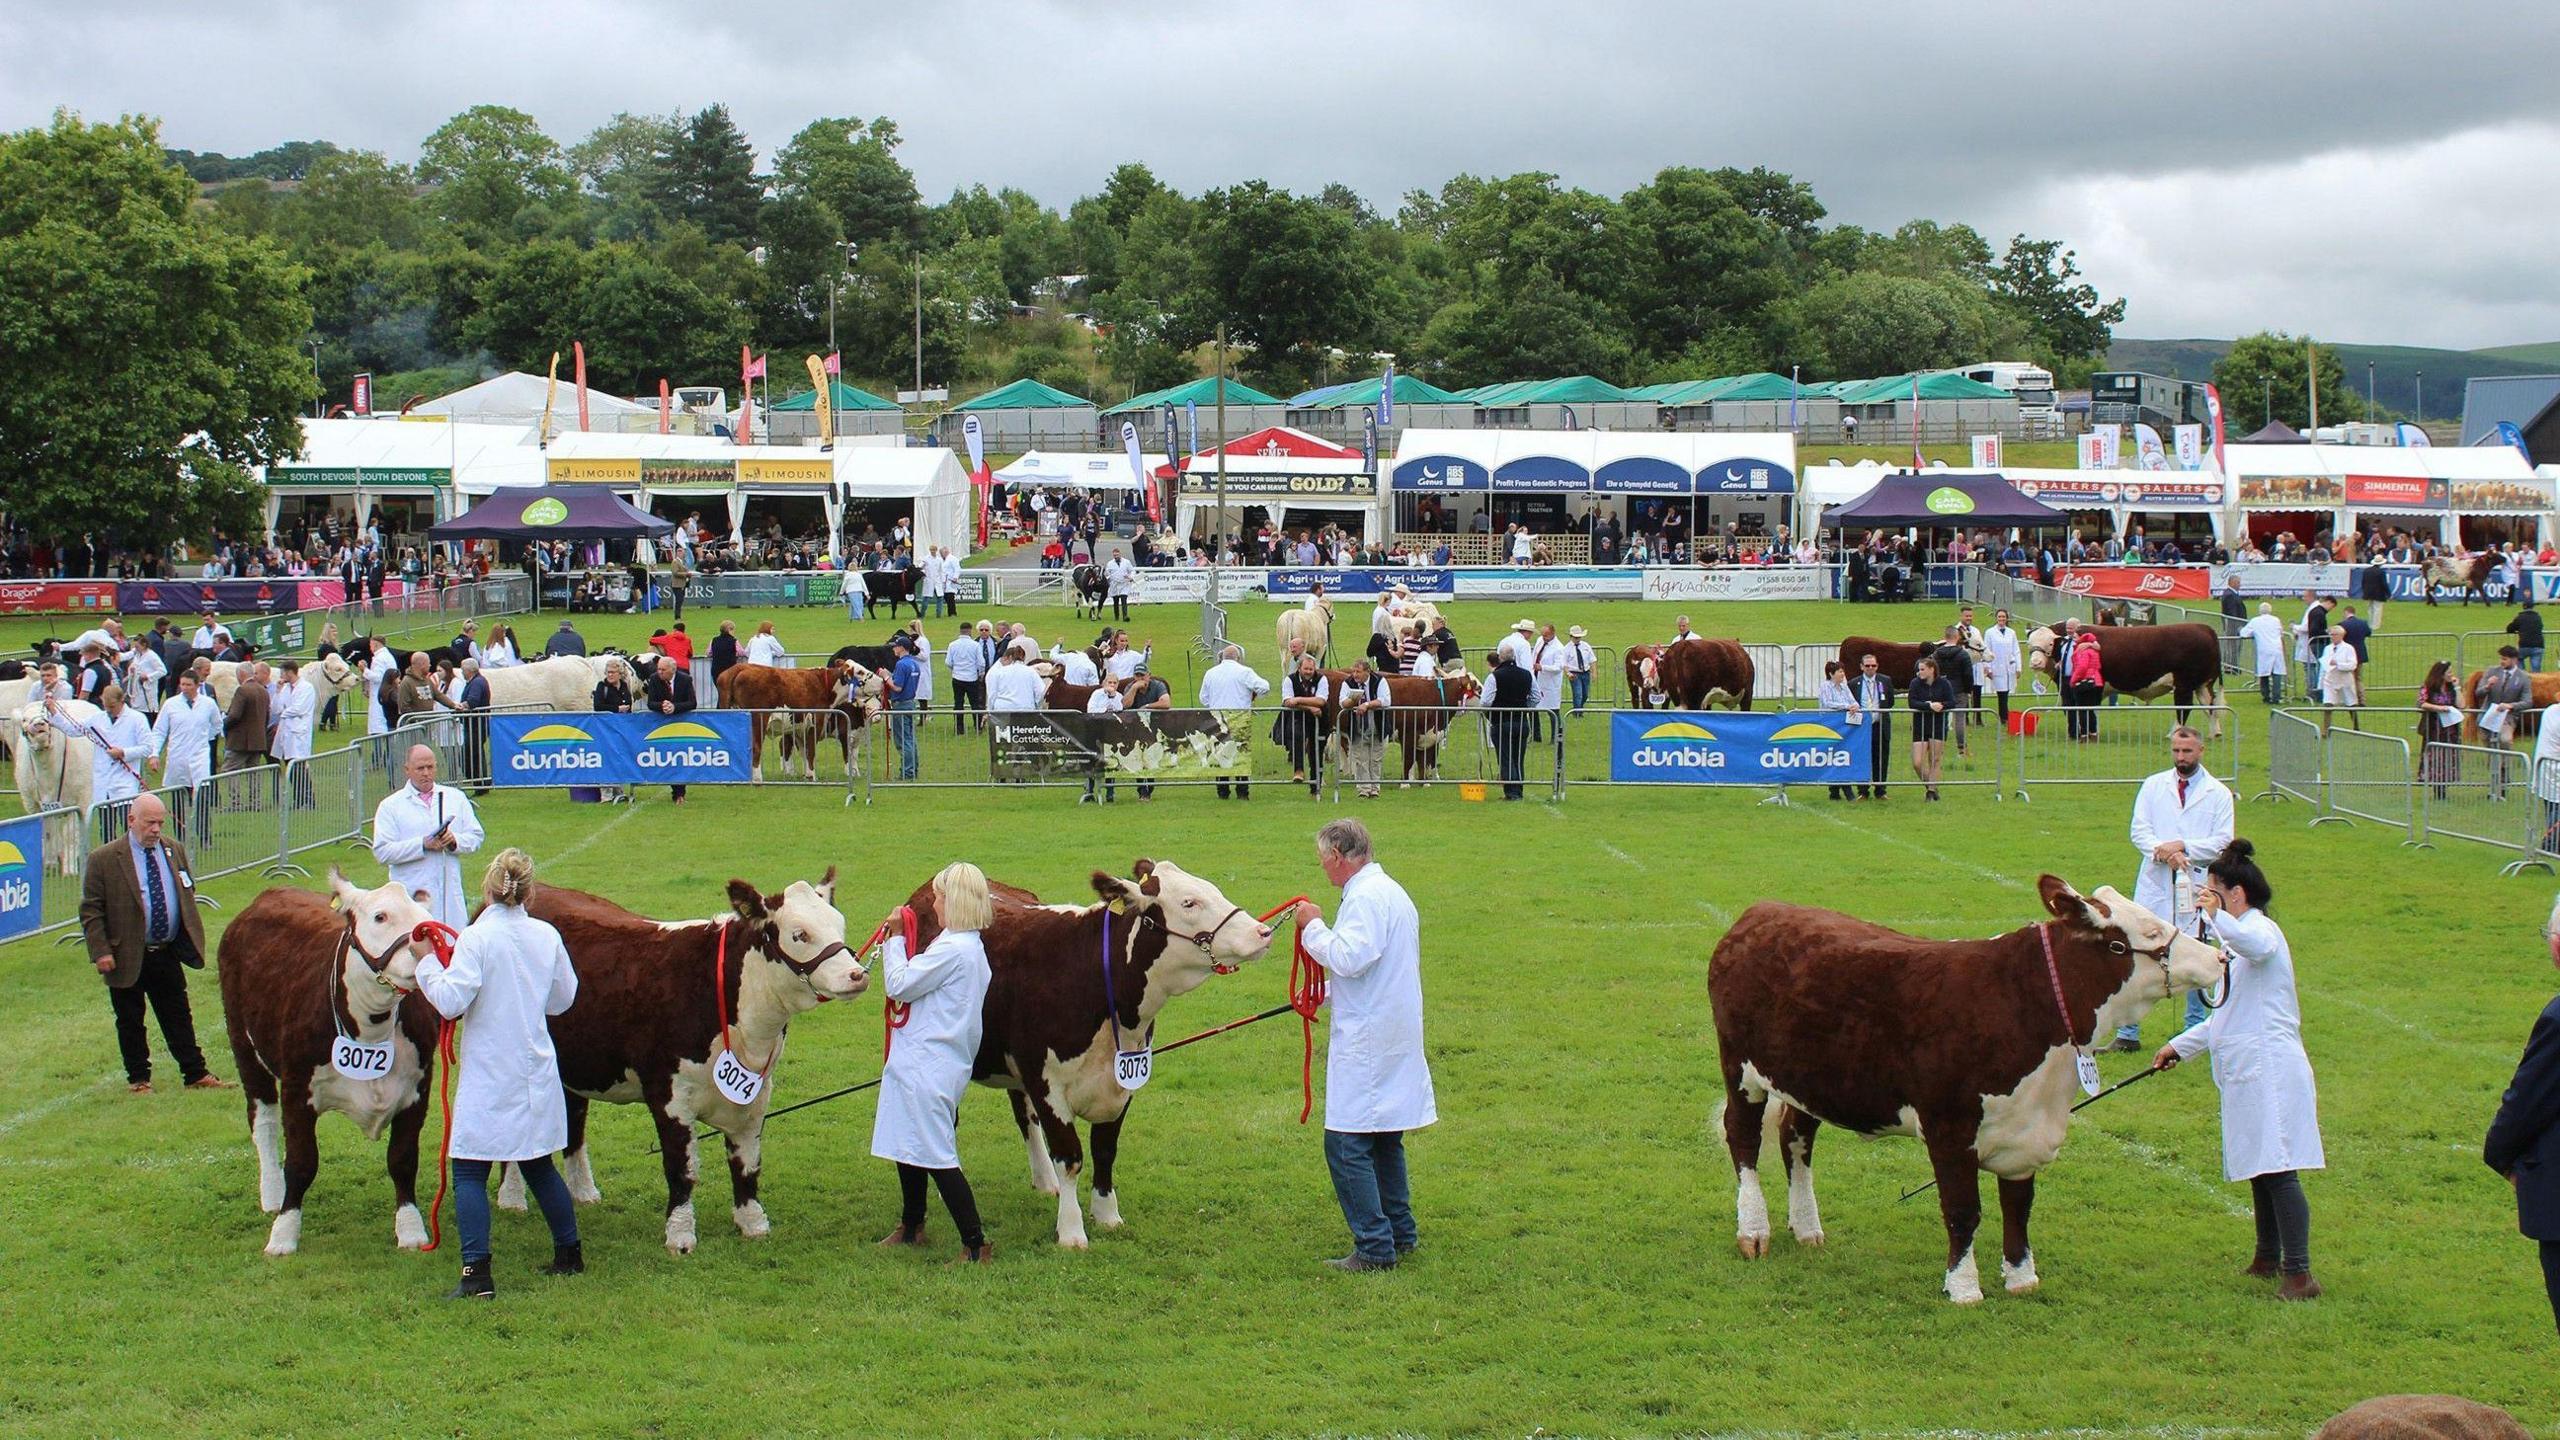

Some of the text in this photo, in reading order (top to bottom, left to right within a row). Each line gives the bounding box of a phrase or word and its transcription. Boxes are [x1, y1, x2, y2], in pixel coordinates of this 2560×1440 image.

[290, 473, 356, 481] SOUTH DEVONS
[359, 473, 427, 481] SOUTH DEVONS
[575, 469, 636, 478] LIMOUSIN
[765, 470, 827, 479] LIMOUSIN
[1290, 476, 1346, 492] GOLD?
[1417, 477, 1444, 486] Genus
[1495, 479, 1514, 487] Profit
[1558, 480, 1587, 489] Progress
[1721, 480, 1748, 489] Genus
[2040, 481, 2100, 491] SALERS
[2364, 481, 2422, 492] SIMMENTAL
[1267, 484, 1288, 492] HAVE
[2143, 484, 2202, 492] SALERS
[1144, 574, 1170, 583] Quality
[2056, 573, 2095, 593] Lister
[2136, 573, 2175, 594] Lister
[1500, 581, 1561, 590] Gamlins
[1566, 581, 1597, 590] Law
[1, 588, 37, 599] Dragon
[1012, 725, 1052, 734] Hereford
[1012, 735, 1071, 745] Cattle Society
[511, 748, 603, 770] dunbia
[636, 746, 730, 768] dunbia
[1632, 746, 1725, 768] dunbia
[1760, 746, 1851, 768] dunbia
[338, 1046, 387, 1071] 3072
[1119, 1056, 1148, 1080] 3073
[718, 1060, 755, 1100] 3074
